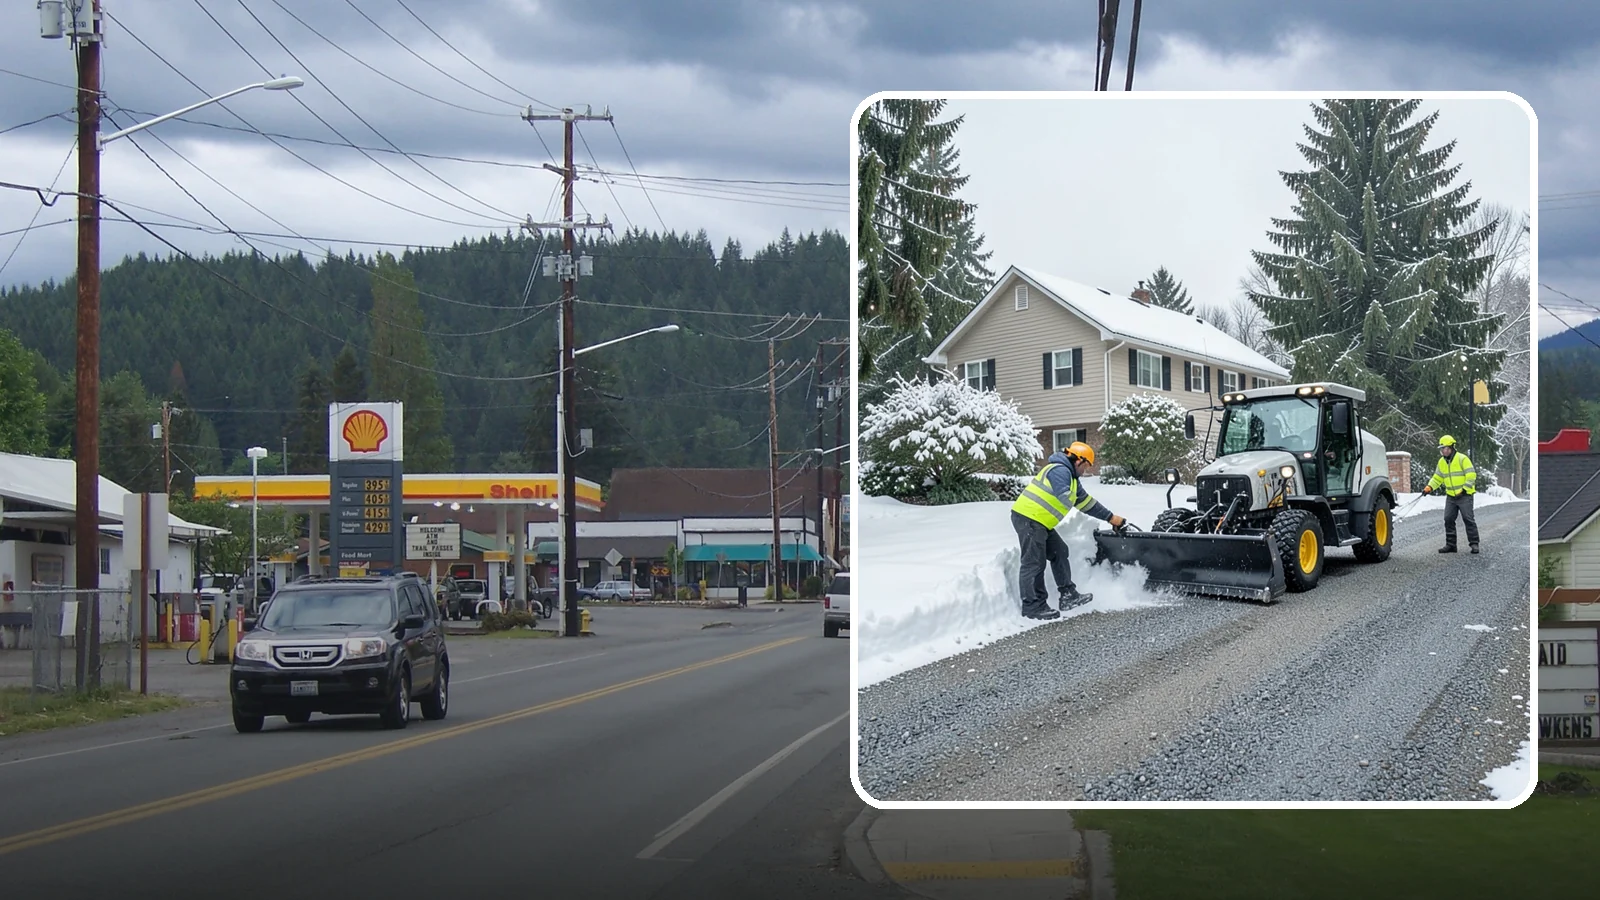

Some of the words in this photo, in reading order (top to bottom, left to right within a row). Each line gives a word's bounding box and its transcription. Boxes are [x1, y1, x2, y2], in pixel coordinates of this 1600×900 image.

[365, 480, 384, 490] 395
[490, 484, 547, 499] Shell
[365, 494, 384, 504] 405
[365, 508, 384, 518] 415
[365, 522, 384, 533] 429
[1539, 643, 1566, 665] AID
[1539, 716, 1592, 738] WKENS
